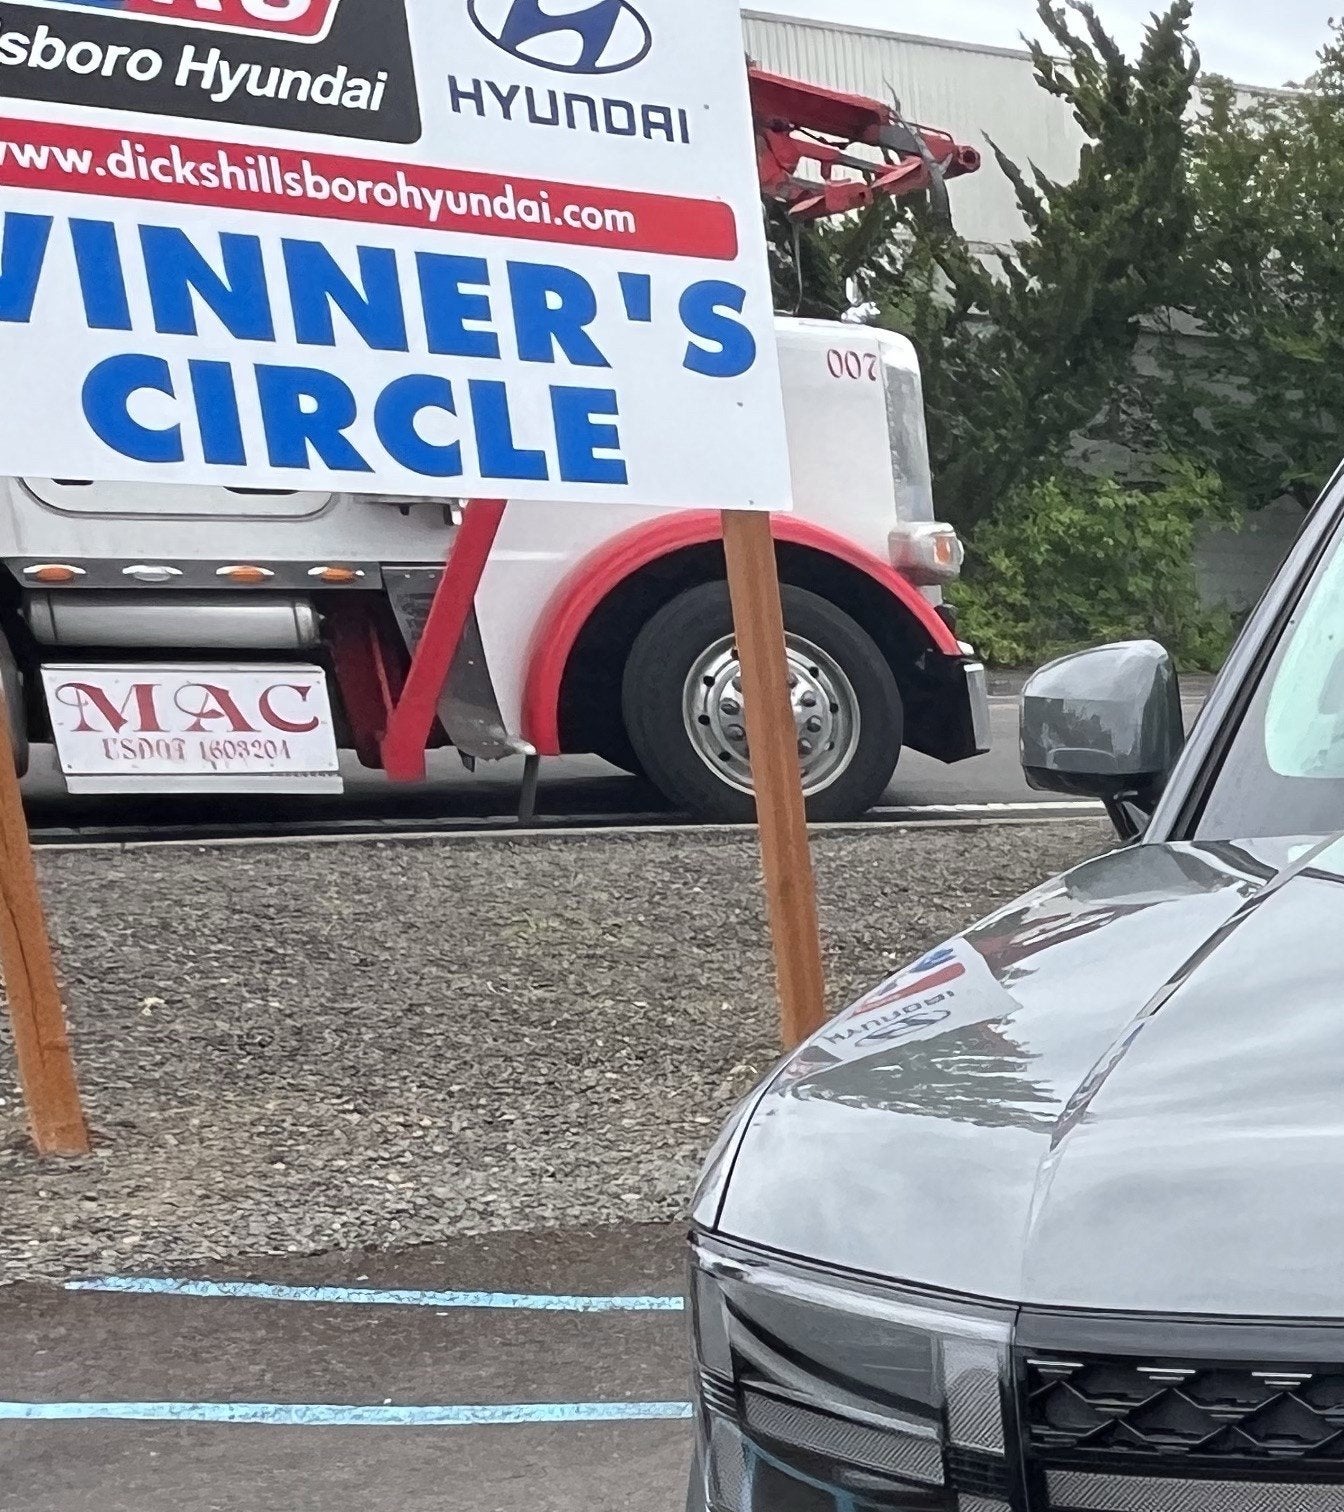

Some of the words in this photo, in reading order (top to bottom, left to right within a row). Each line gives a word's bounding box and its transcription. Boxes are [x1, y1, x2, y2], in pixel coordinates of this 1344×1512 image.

[0, 25, 163, 82] sboro
[175, 44, 389, 112] Hyundai
[447, 74, 690, 144] HYUNDAI
[0, 139, 637, 234] ww.dickshillsborohyundai.com
[826, 348, 877, 381] 007
[82, 353, 629, 485] CIRCLE
[55, 682, 319, 734] MAC
[102, 737, 186, 761] USDOT
